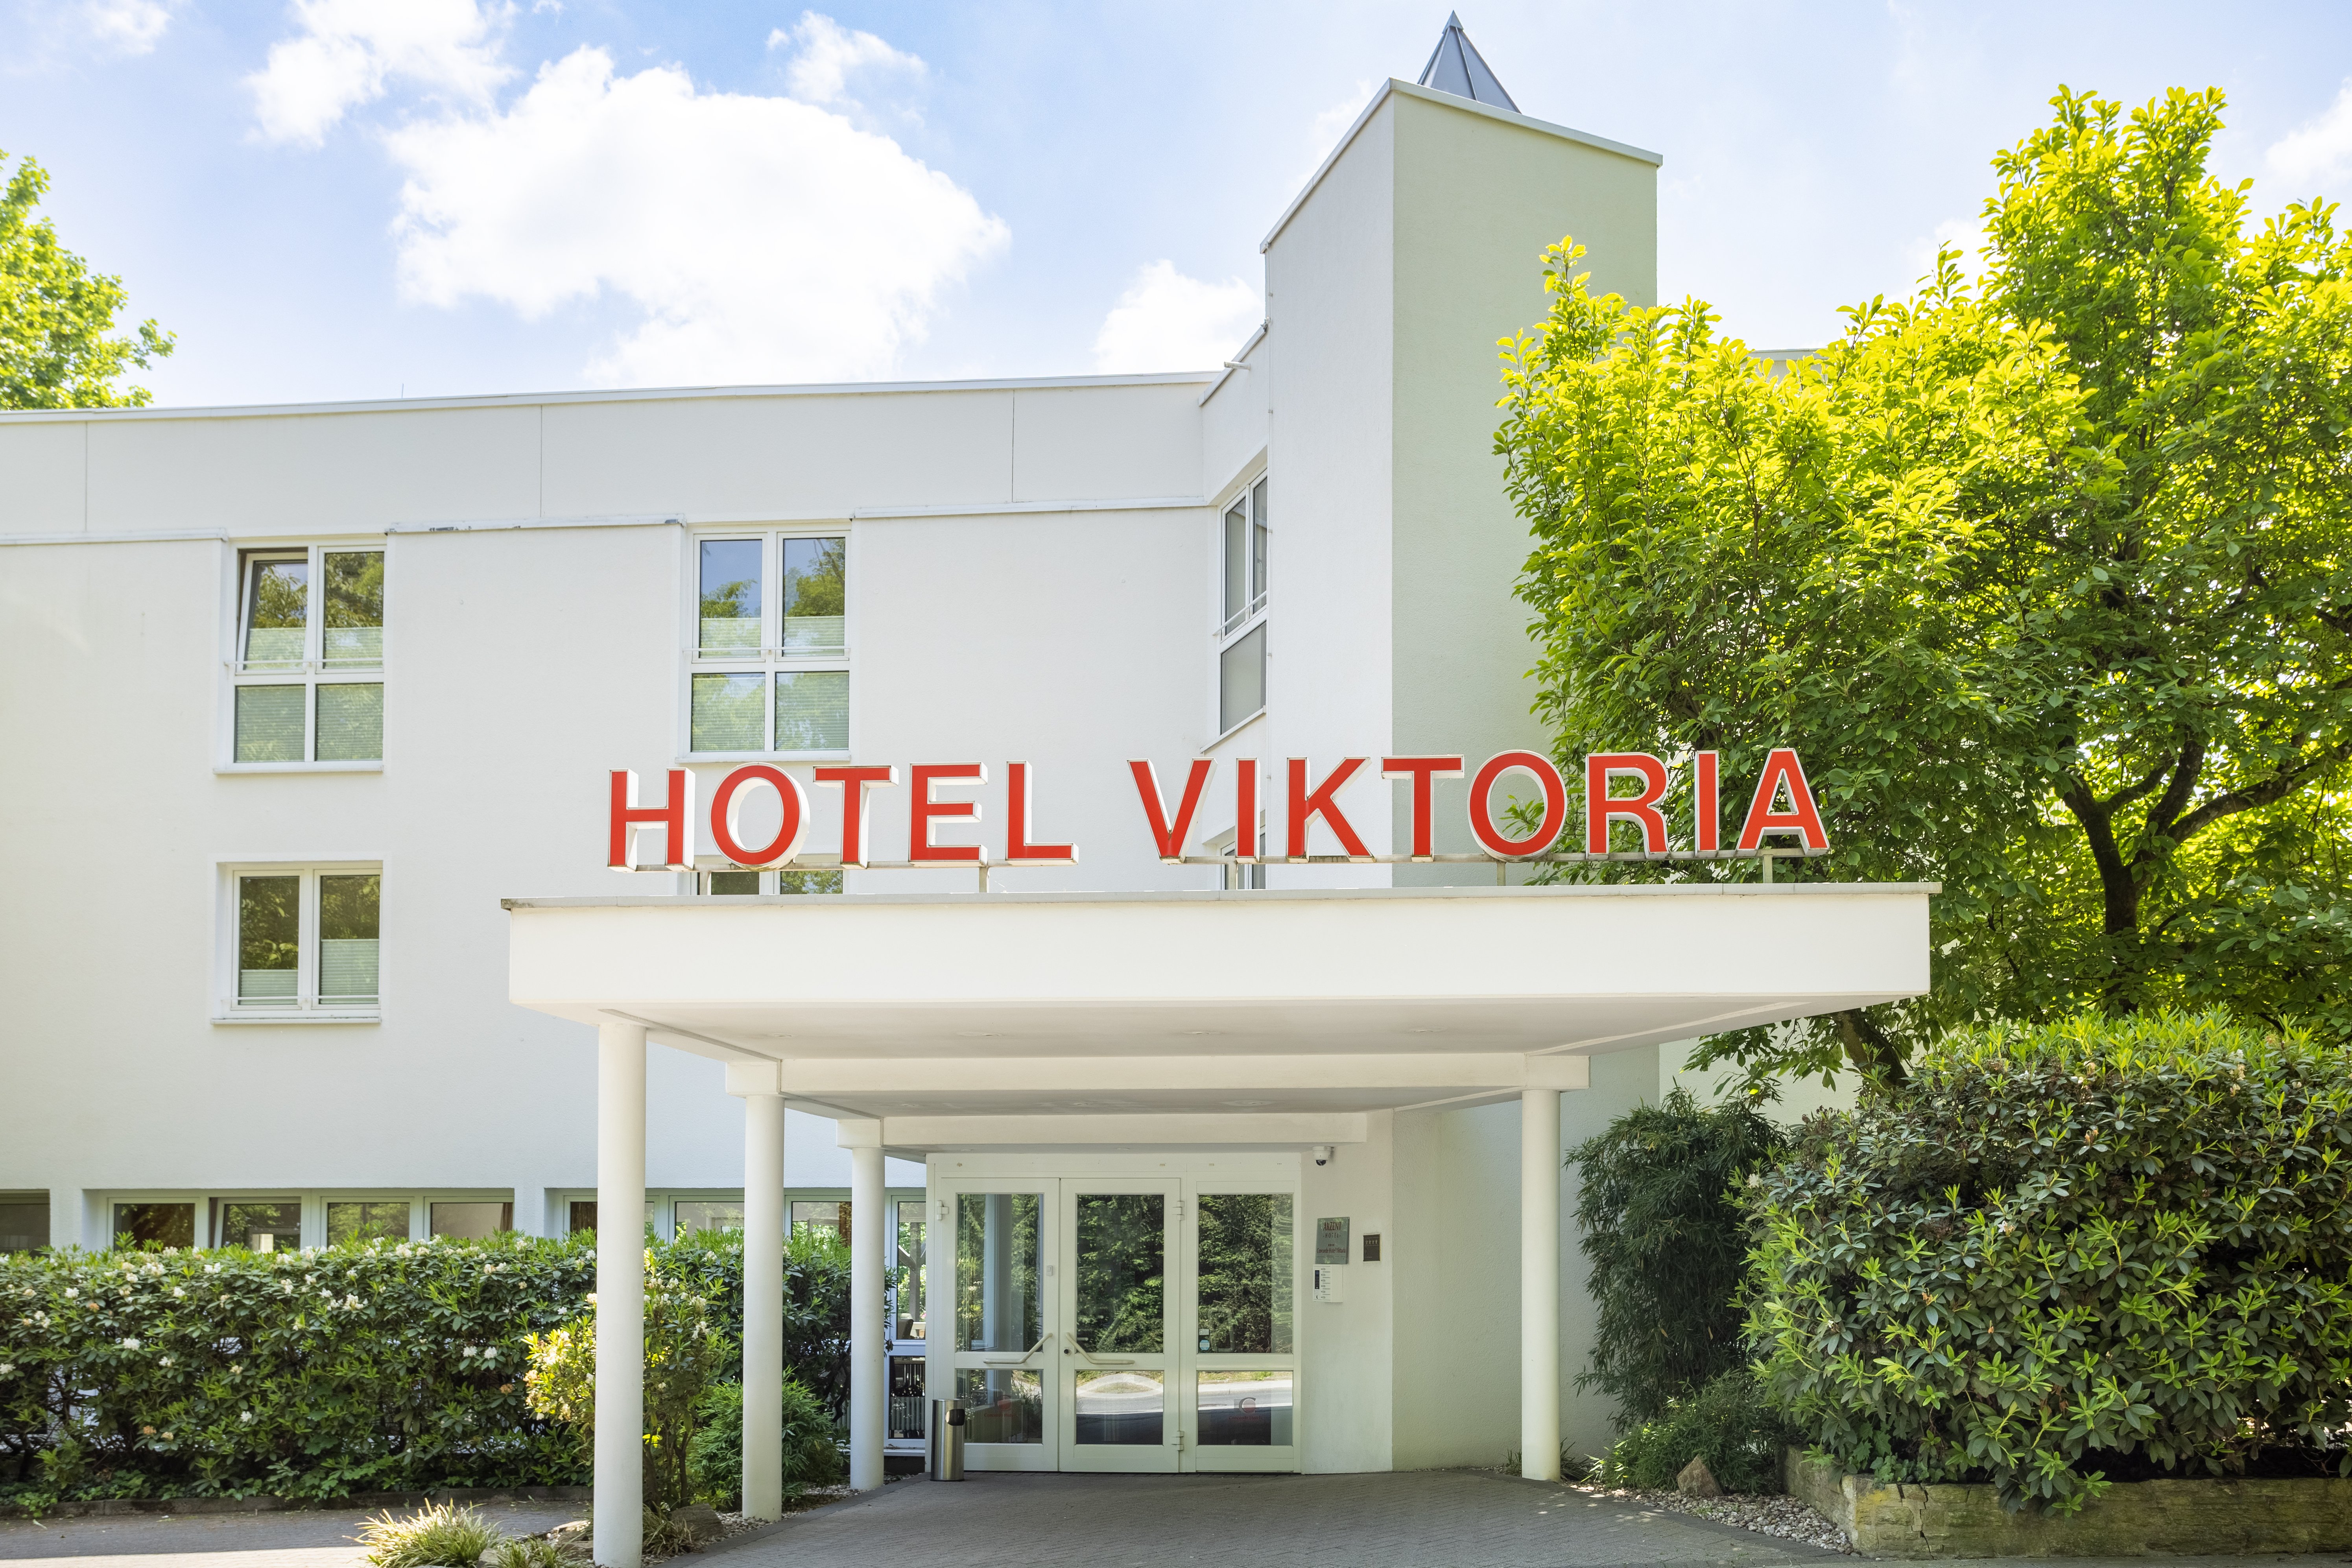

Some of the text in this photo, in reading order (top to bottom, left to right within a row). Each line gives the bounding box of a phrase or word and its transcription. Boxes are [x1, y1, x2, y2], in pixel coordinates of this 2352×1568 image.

[608, 748, 1830, 873] HOTEL VIKTORIA
[1323, 1221, 1342, 1231] AKZENT
